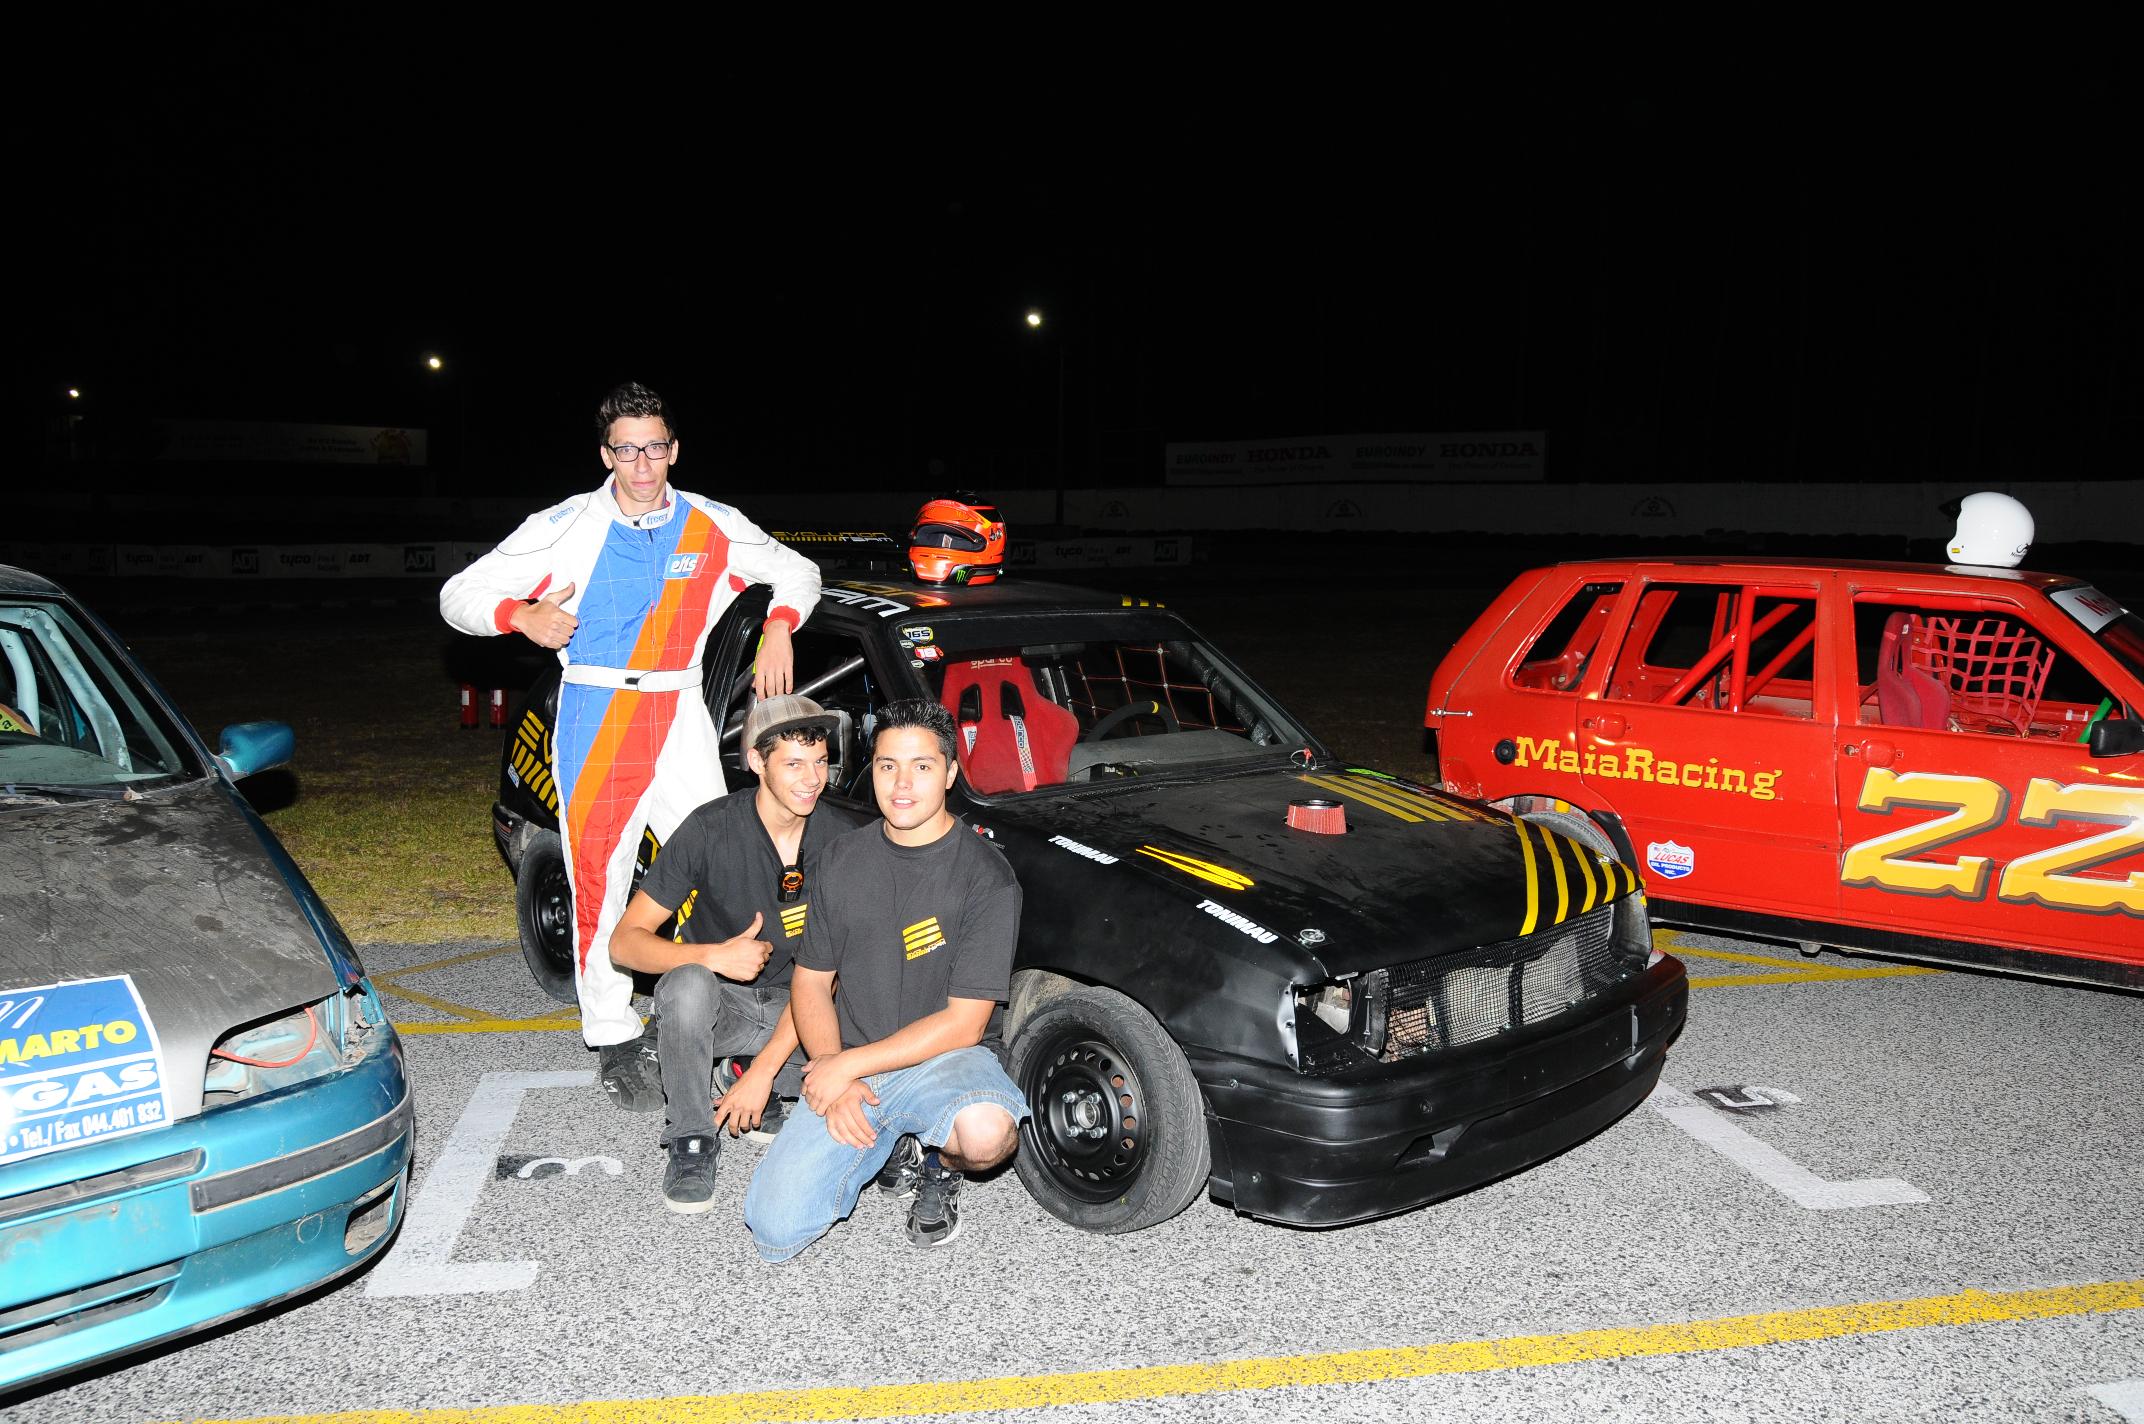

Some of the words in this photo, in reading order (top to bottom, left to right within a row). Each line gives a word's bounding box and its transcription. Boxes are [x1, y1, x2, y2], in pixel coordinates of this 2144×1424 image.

[1247, 446, 1332, 463] HONDA
[1355, 446, 1426, 457] EUROINDY
[1439, 442, 1539, 458] HONDA
[404, 549, 436, 570] ADT
[1514, 736, 1783, 800] MaiaRacing
[1048, 835, 1120, 865] TONIMAU
[1840, 766, 2144, 916] 22
[1654, 852, 1690, 864] LUCAS
[1196, 899, 1279, 944] TONIMAU
[136, 1099, 163, 1123] 832
